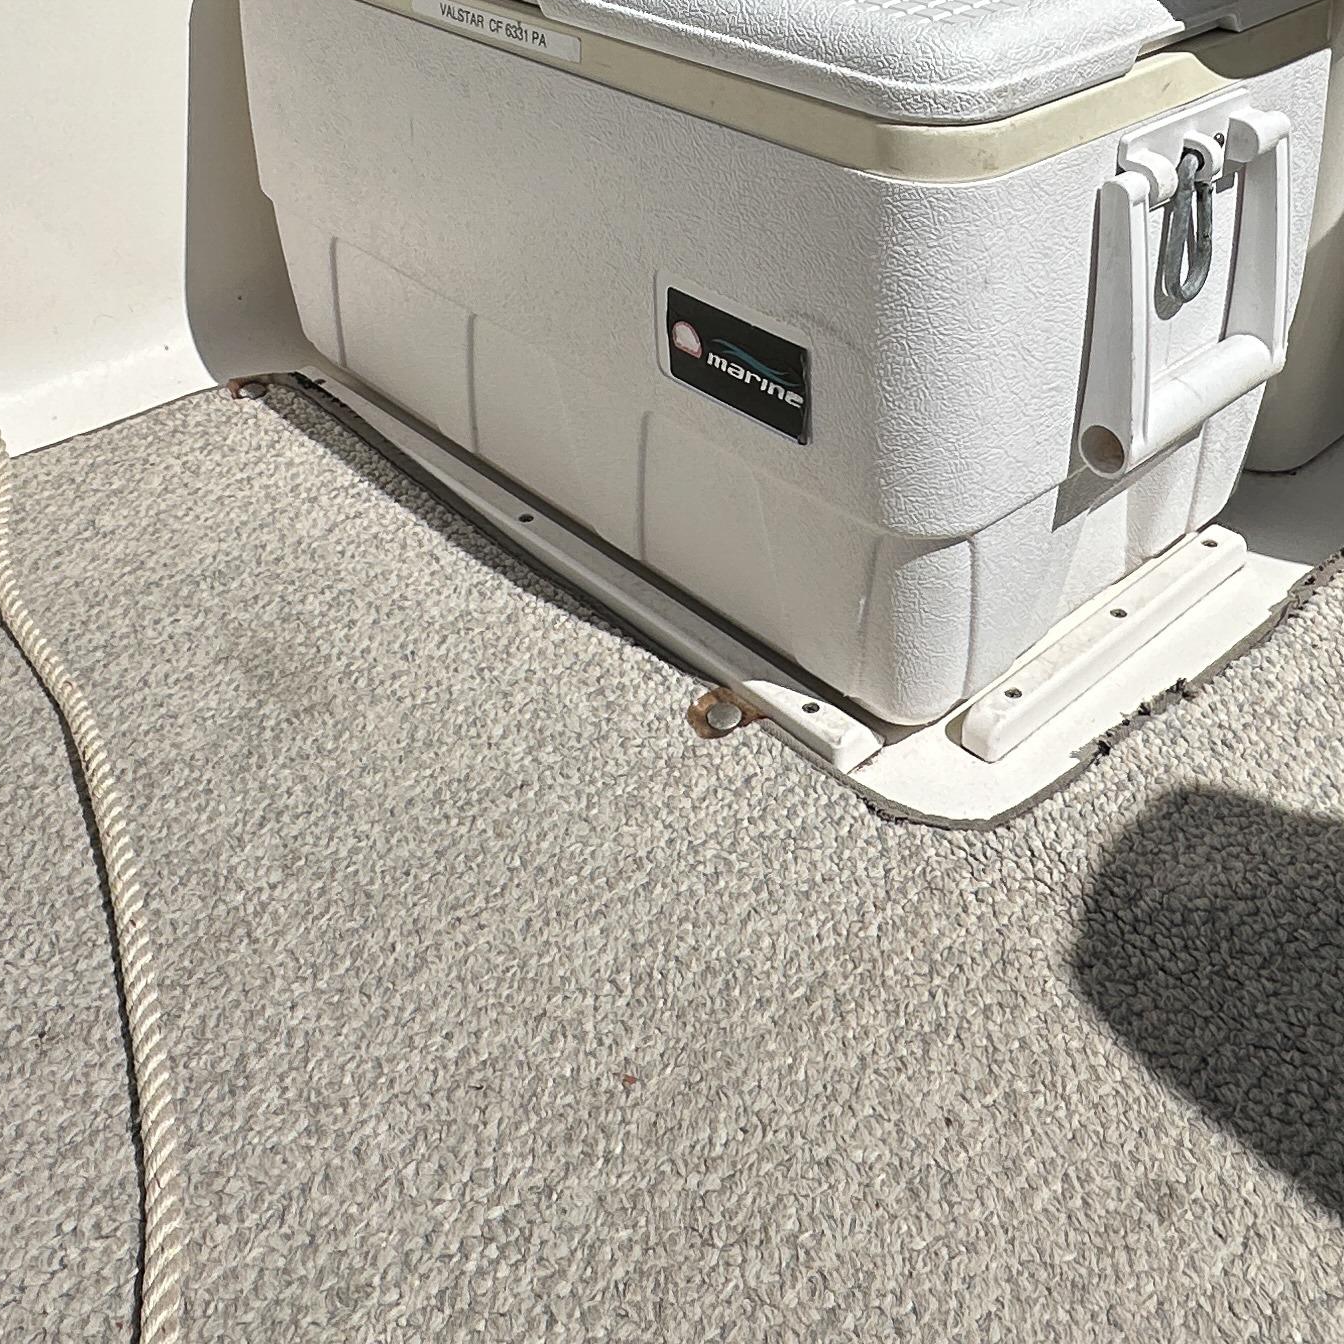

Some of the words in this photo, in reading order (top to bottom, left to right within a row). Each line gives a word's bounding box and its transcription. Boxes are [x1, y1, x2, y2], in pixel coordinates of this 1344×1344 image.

[439, 2, 485, 29] VALSTAR
[489, 18, 504, 33] CF
[505, 23, 528, 42] 6331
[532, 30, 548, 49] PA
[706, 352, 804, 409] marine
